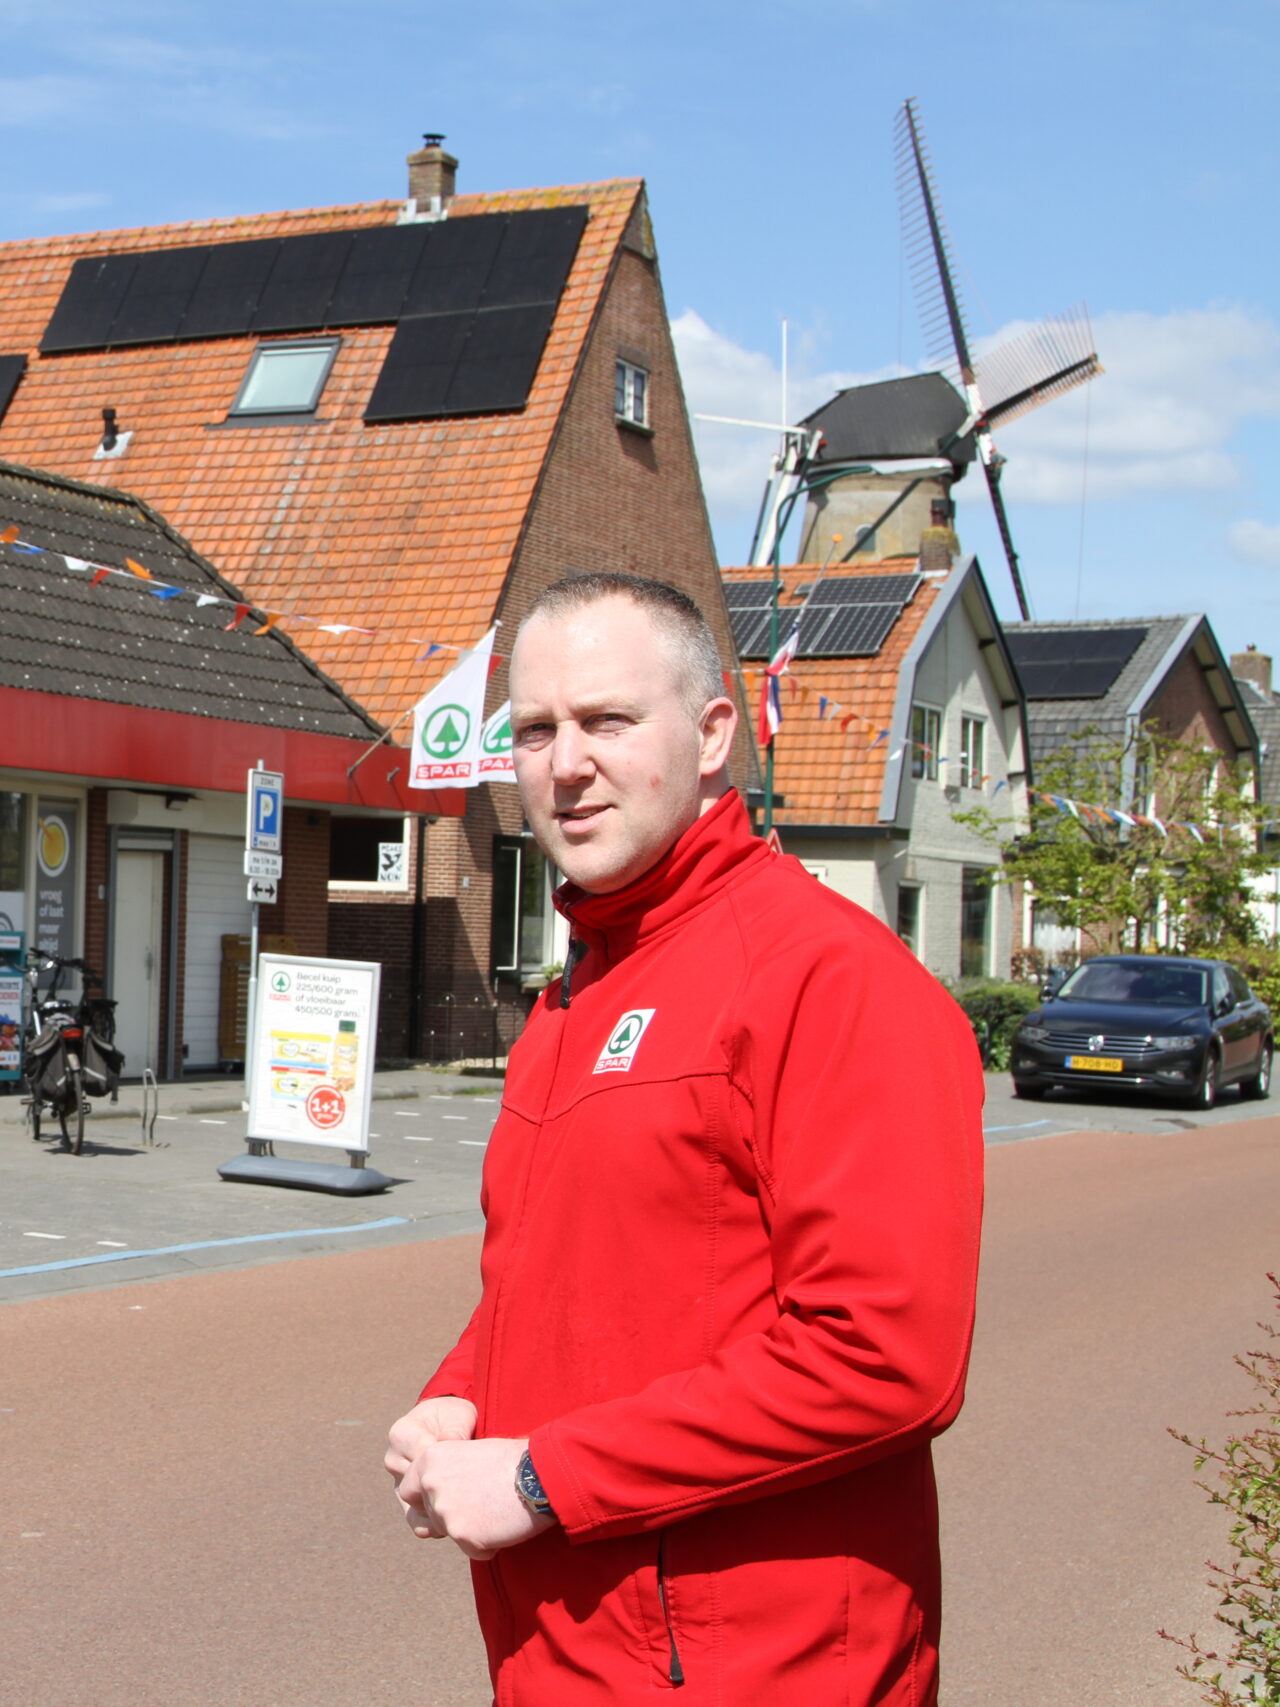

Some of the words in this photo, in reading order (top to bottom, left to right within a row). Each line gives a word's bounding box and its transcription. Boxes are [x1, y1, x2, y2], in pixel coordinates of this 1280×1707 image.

[417, 763, 470, 778] SPAR
[260, 793, 274, 830] P
[297, 973, 320, 981] Becel
[323, 974, 340, 984] kuip
[296, 983, 333, 993] 225/600
[335, 987, 358, 996] gram
[296, 994, 304, 1002] of
[306, 997, 347, 1006] vloeibaar
[295, 1005, 332, 1016] 450/500
[596, 1058, 628, 1070] SPAR
[312, 1098, 340, 1114] 1+1
